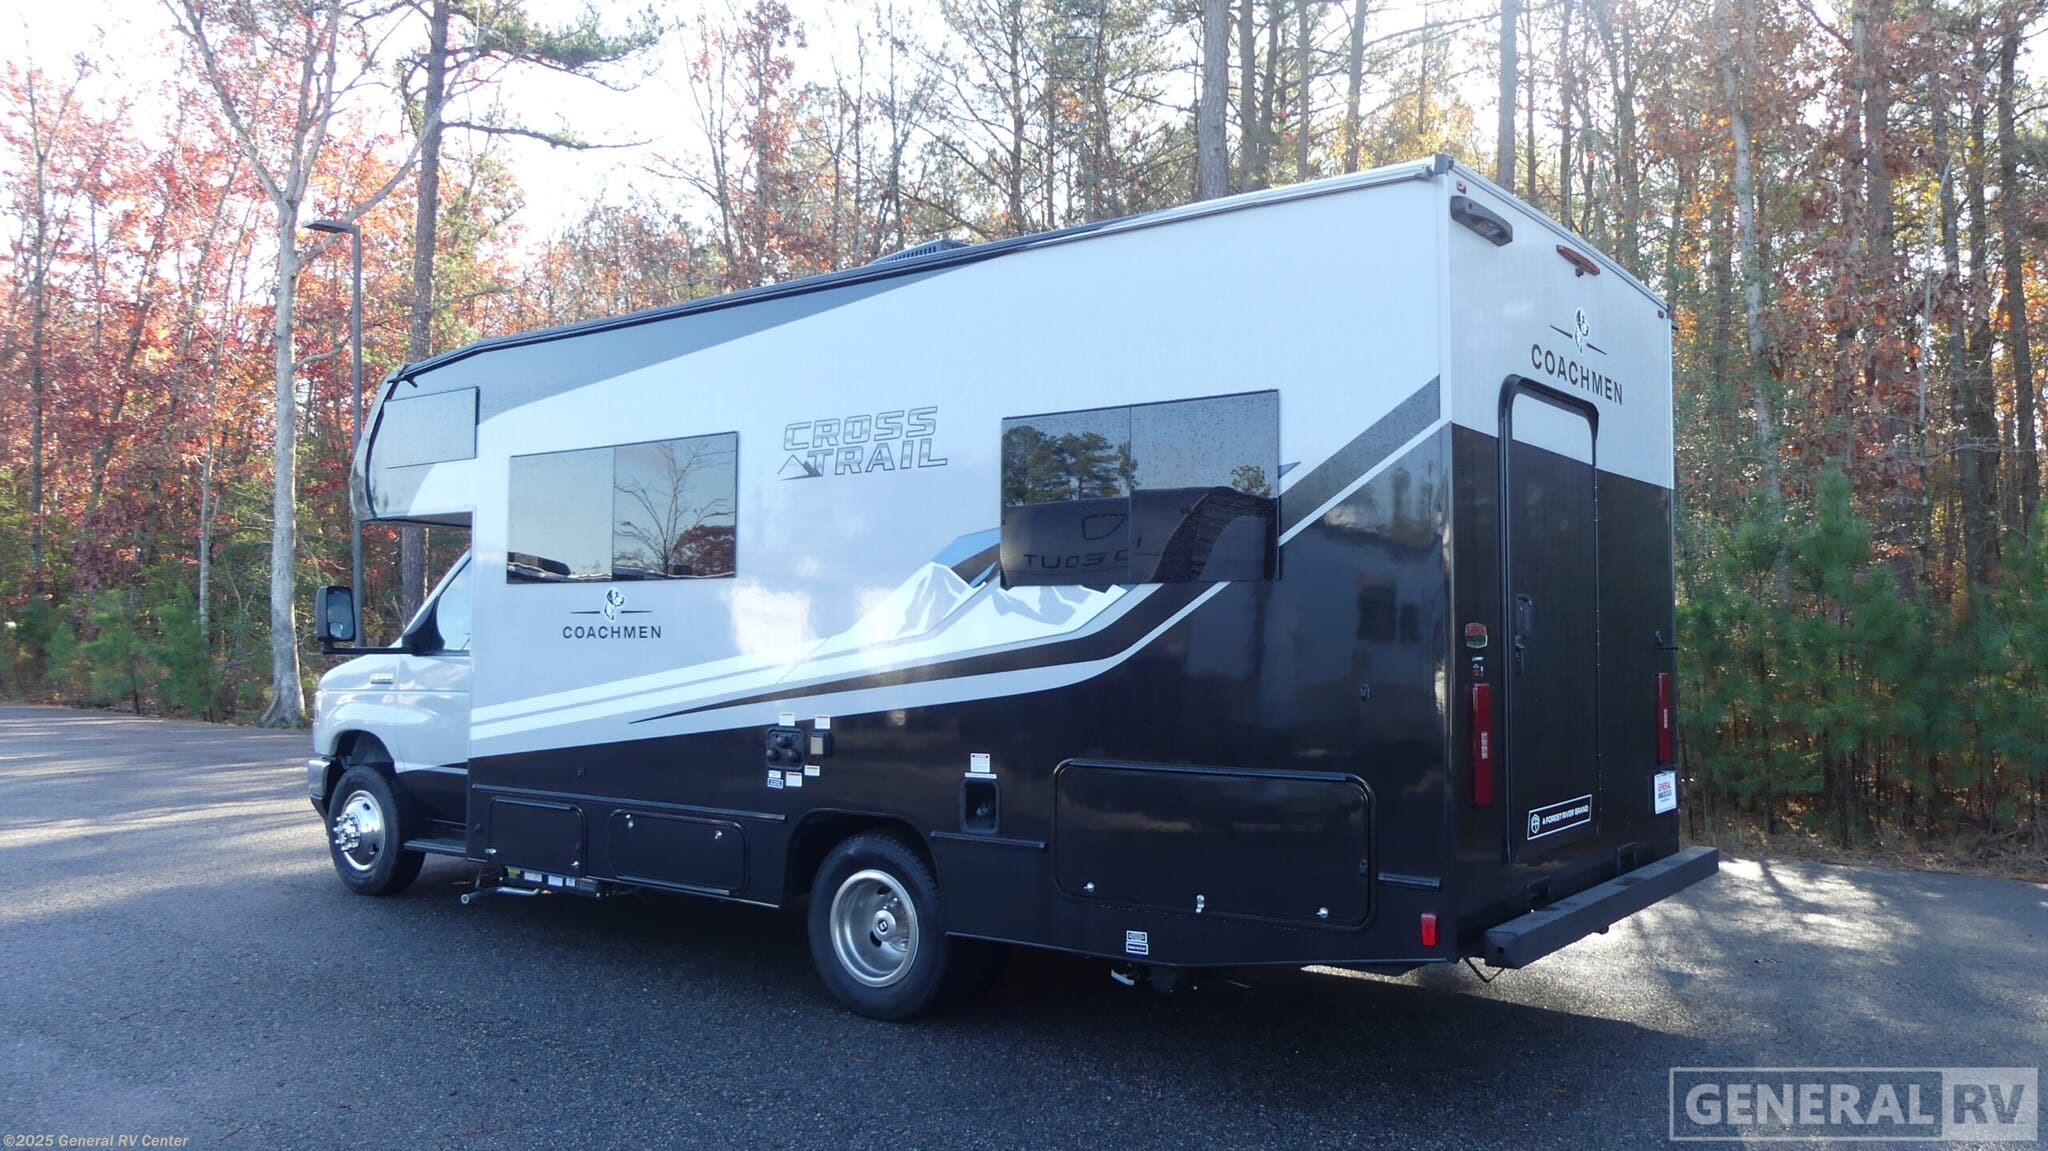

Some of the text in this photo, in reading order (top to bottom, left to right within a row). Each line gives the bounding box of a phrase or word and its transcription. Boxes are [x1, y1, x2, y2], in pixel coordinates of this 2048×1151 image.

[1531, 343, 1623, 405] COACHMEN
[783, 405, 939, 451] CROSS
[807, 438, 948, 477] TRAIL
[562, 625, 662, 640] COACHMEN
